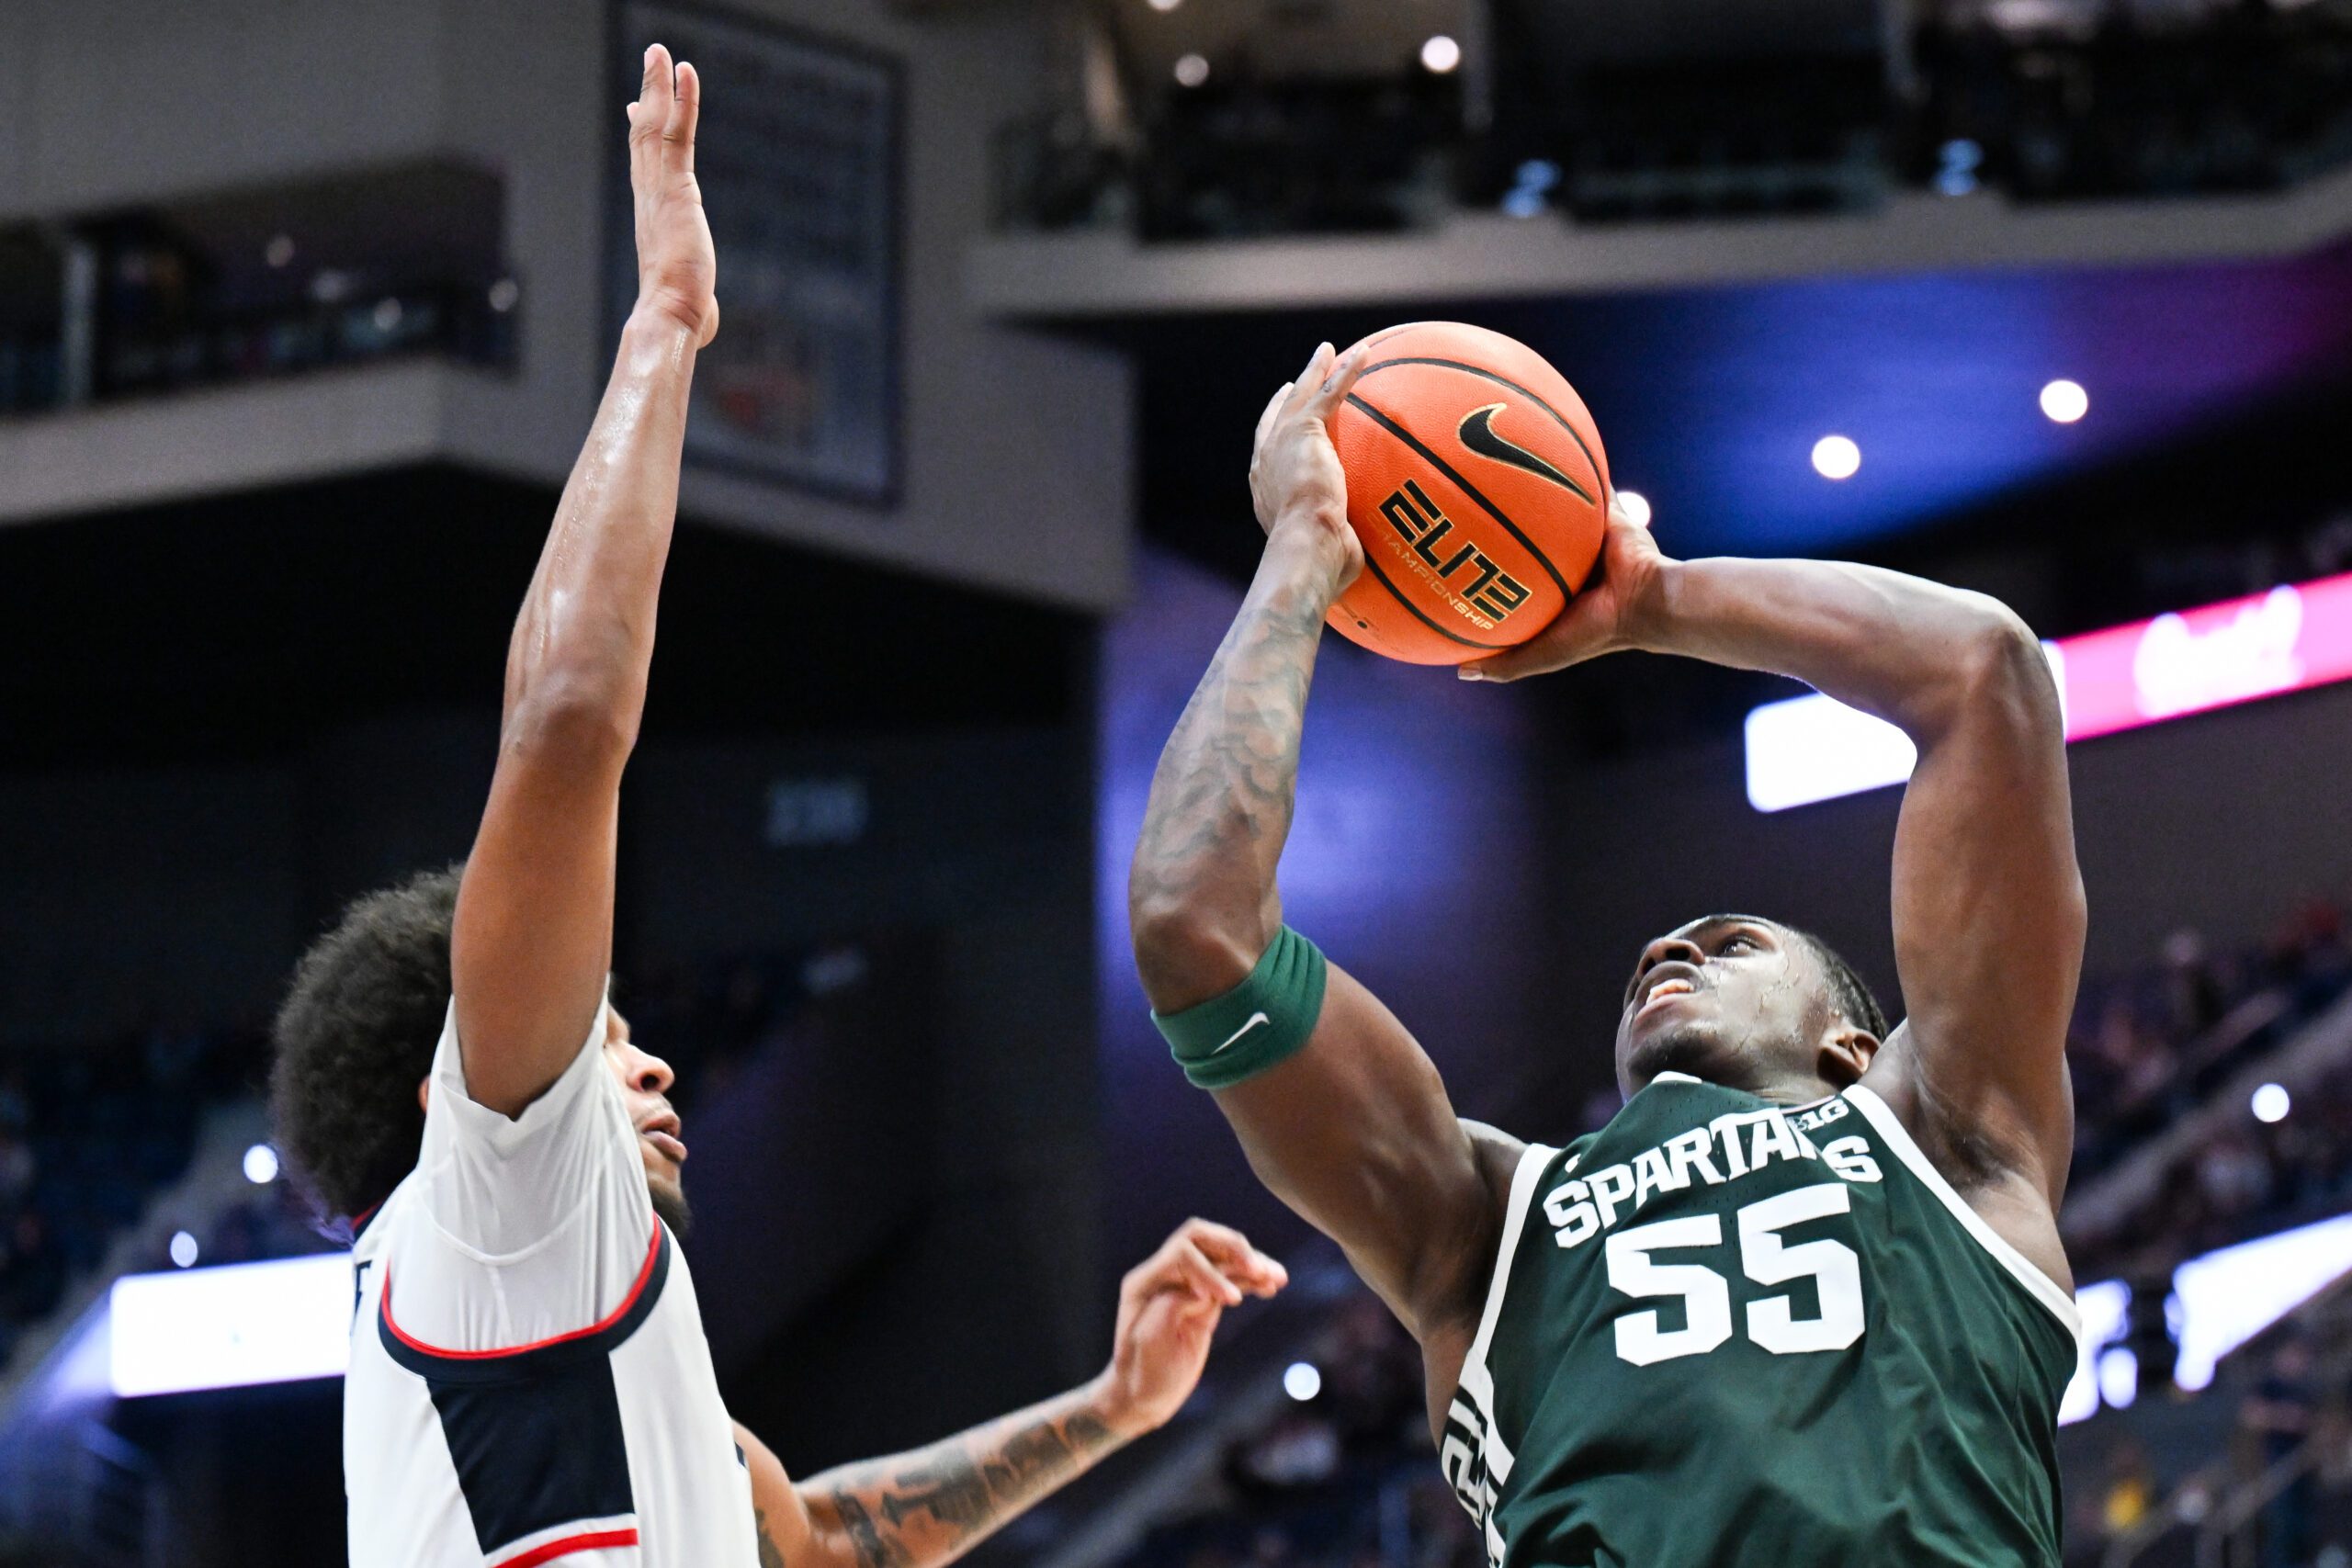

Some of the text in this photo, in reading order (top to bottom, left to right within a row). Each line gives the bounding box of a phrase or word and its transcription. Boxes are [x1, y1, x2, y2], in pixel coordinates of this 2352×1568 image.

[1365, 512, 1495, 630] AMPIONSHIP
[1377, 478, 1533, 623] ELITE
[1605, 1182, 1866, 1367] 55
